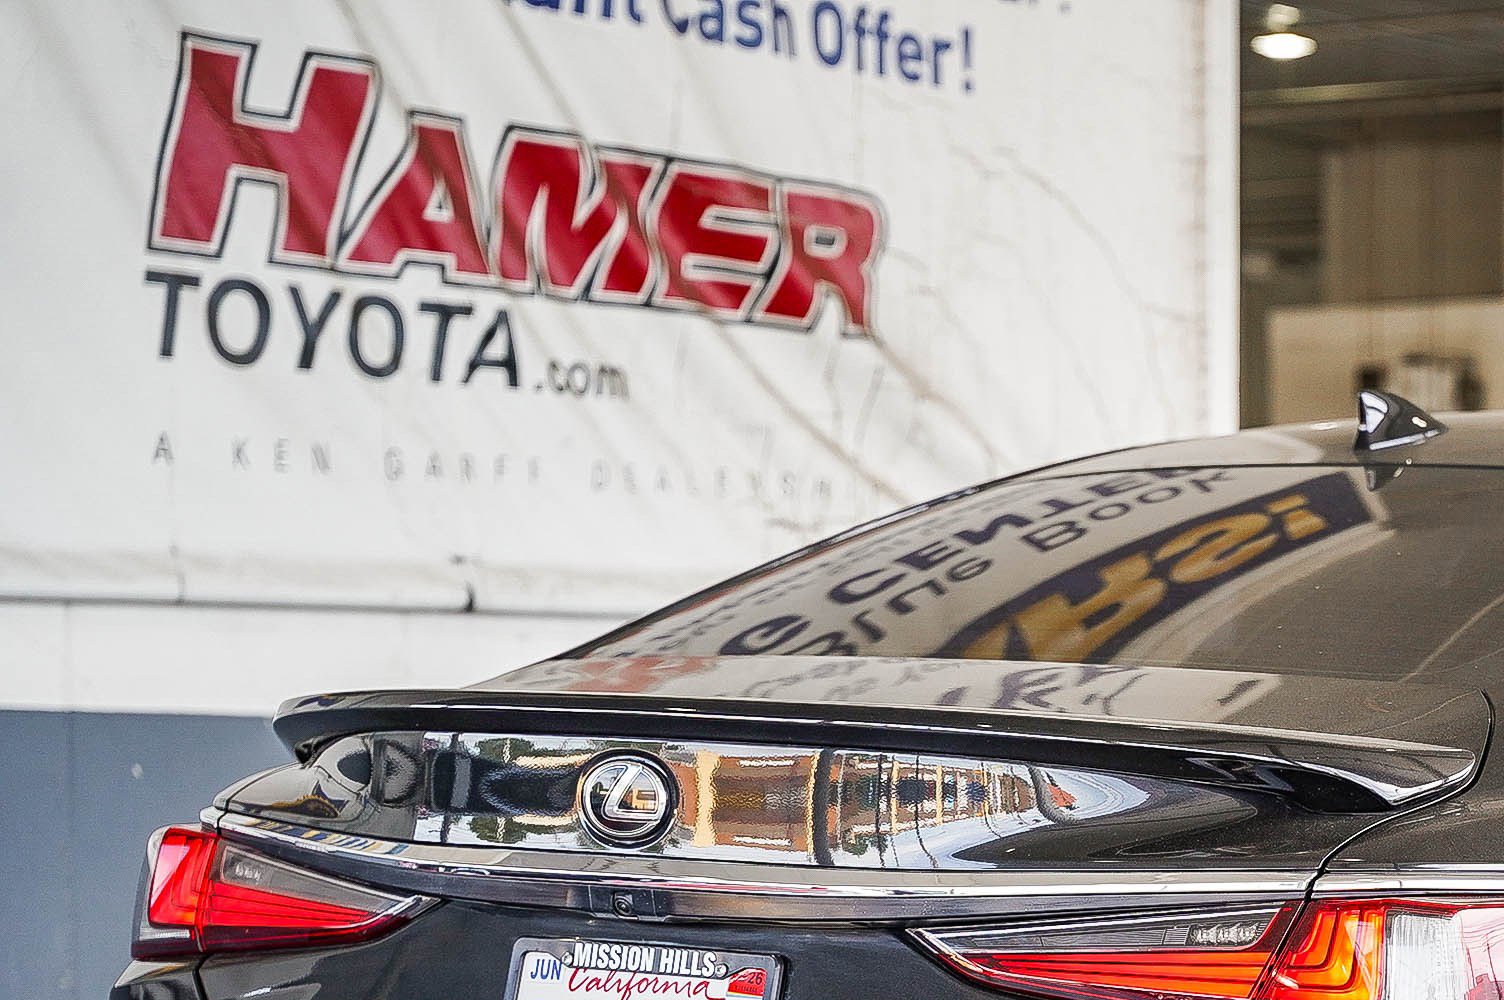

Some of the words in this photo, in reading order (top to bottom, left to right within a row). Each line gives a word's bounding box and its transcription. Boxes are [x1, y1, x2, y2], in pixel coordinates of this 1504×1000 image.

[813, 1, 976, 92] Offer!
[147, 28, 886, 341] HAMER
[230, 436, 334, 476] KEN
[530, 958, 562, 981] JUN
[572, 942, 656, 973] MISSION
[659, 948, 717, 979] HILLS
